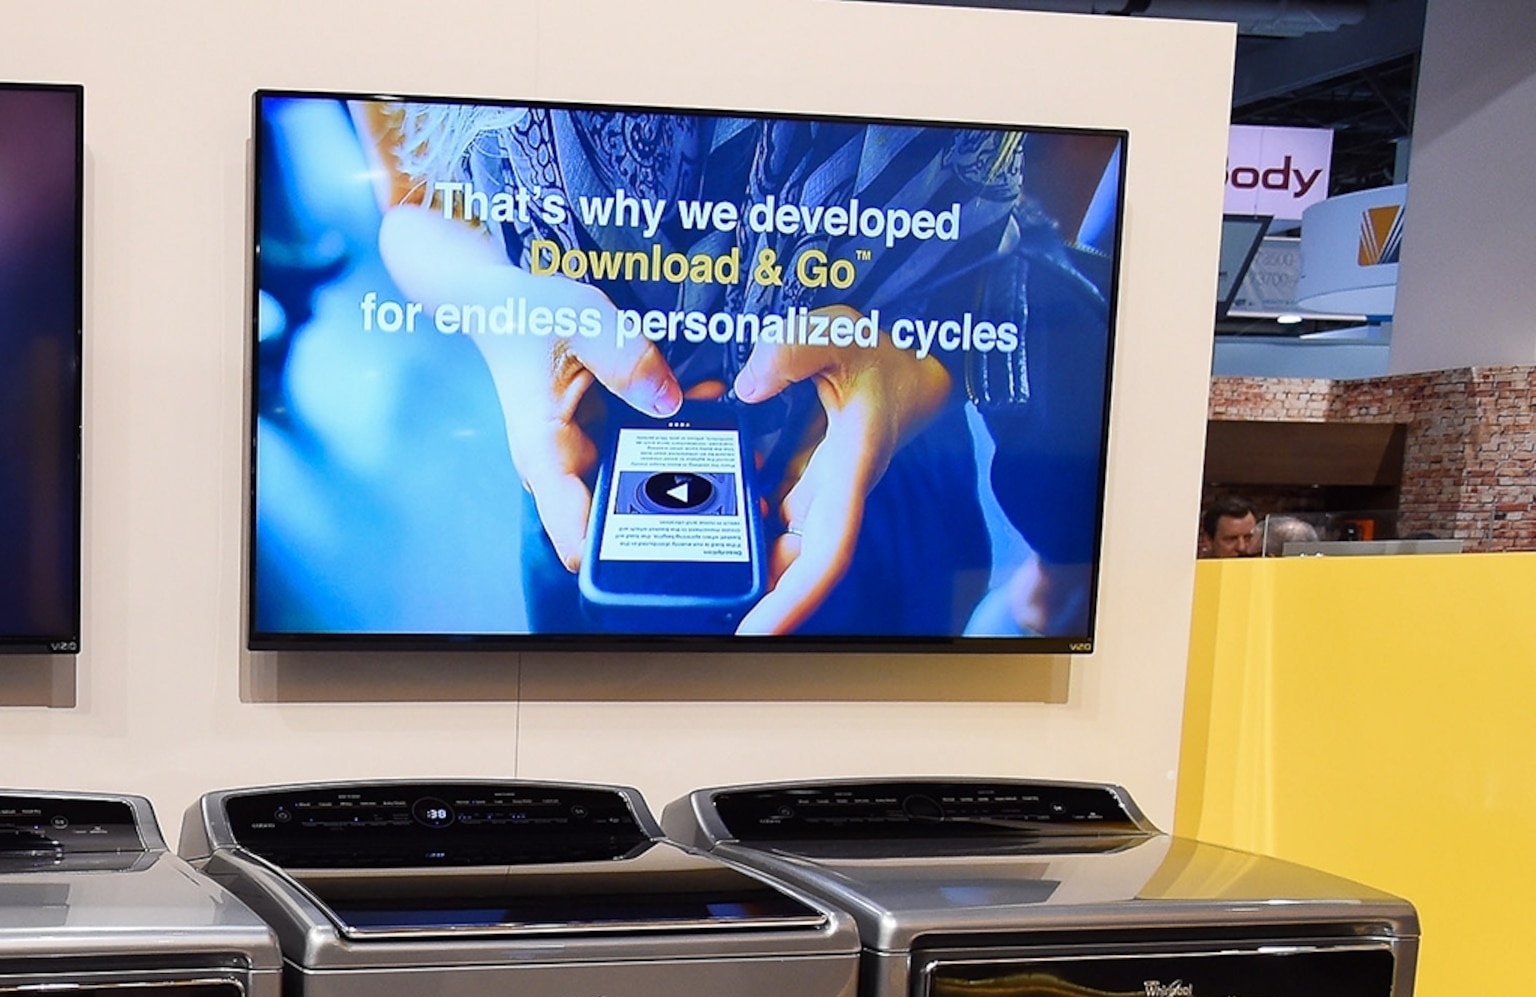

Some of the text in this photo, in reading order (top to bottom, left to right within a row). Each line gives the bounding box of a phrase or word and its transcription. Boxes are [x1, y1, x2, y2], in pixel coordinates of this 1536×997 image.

[1225, 155, 1323, 198] ody
[578, 188, 666, 239] why
[677, 198, 739, 233] we
[748, 194, 962, 249] developed
[530, 239, 740, 285] Download
[753, 247, 783, 287] &
[359, 291, 1020, 360] for endless personalized cycles
